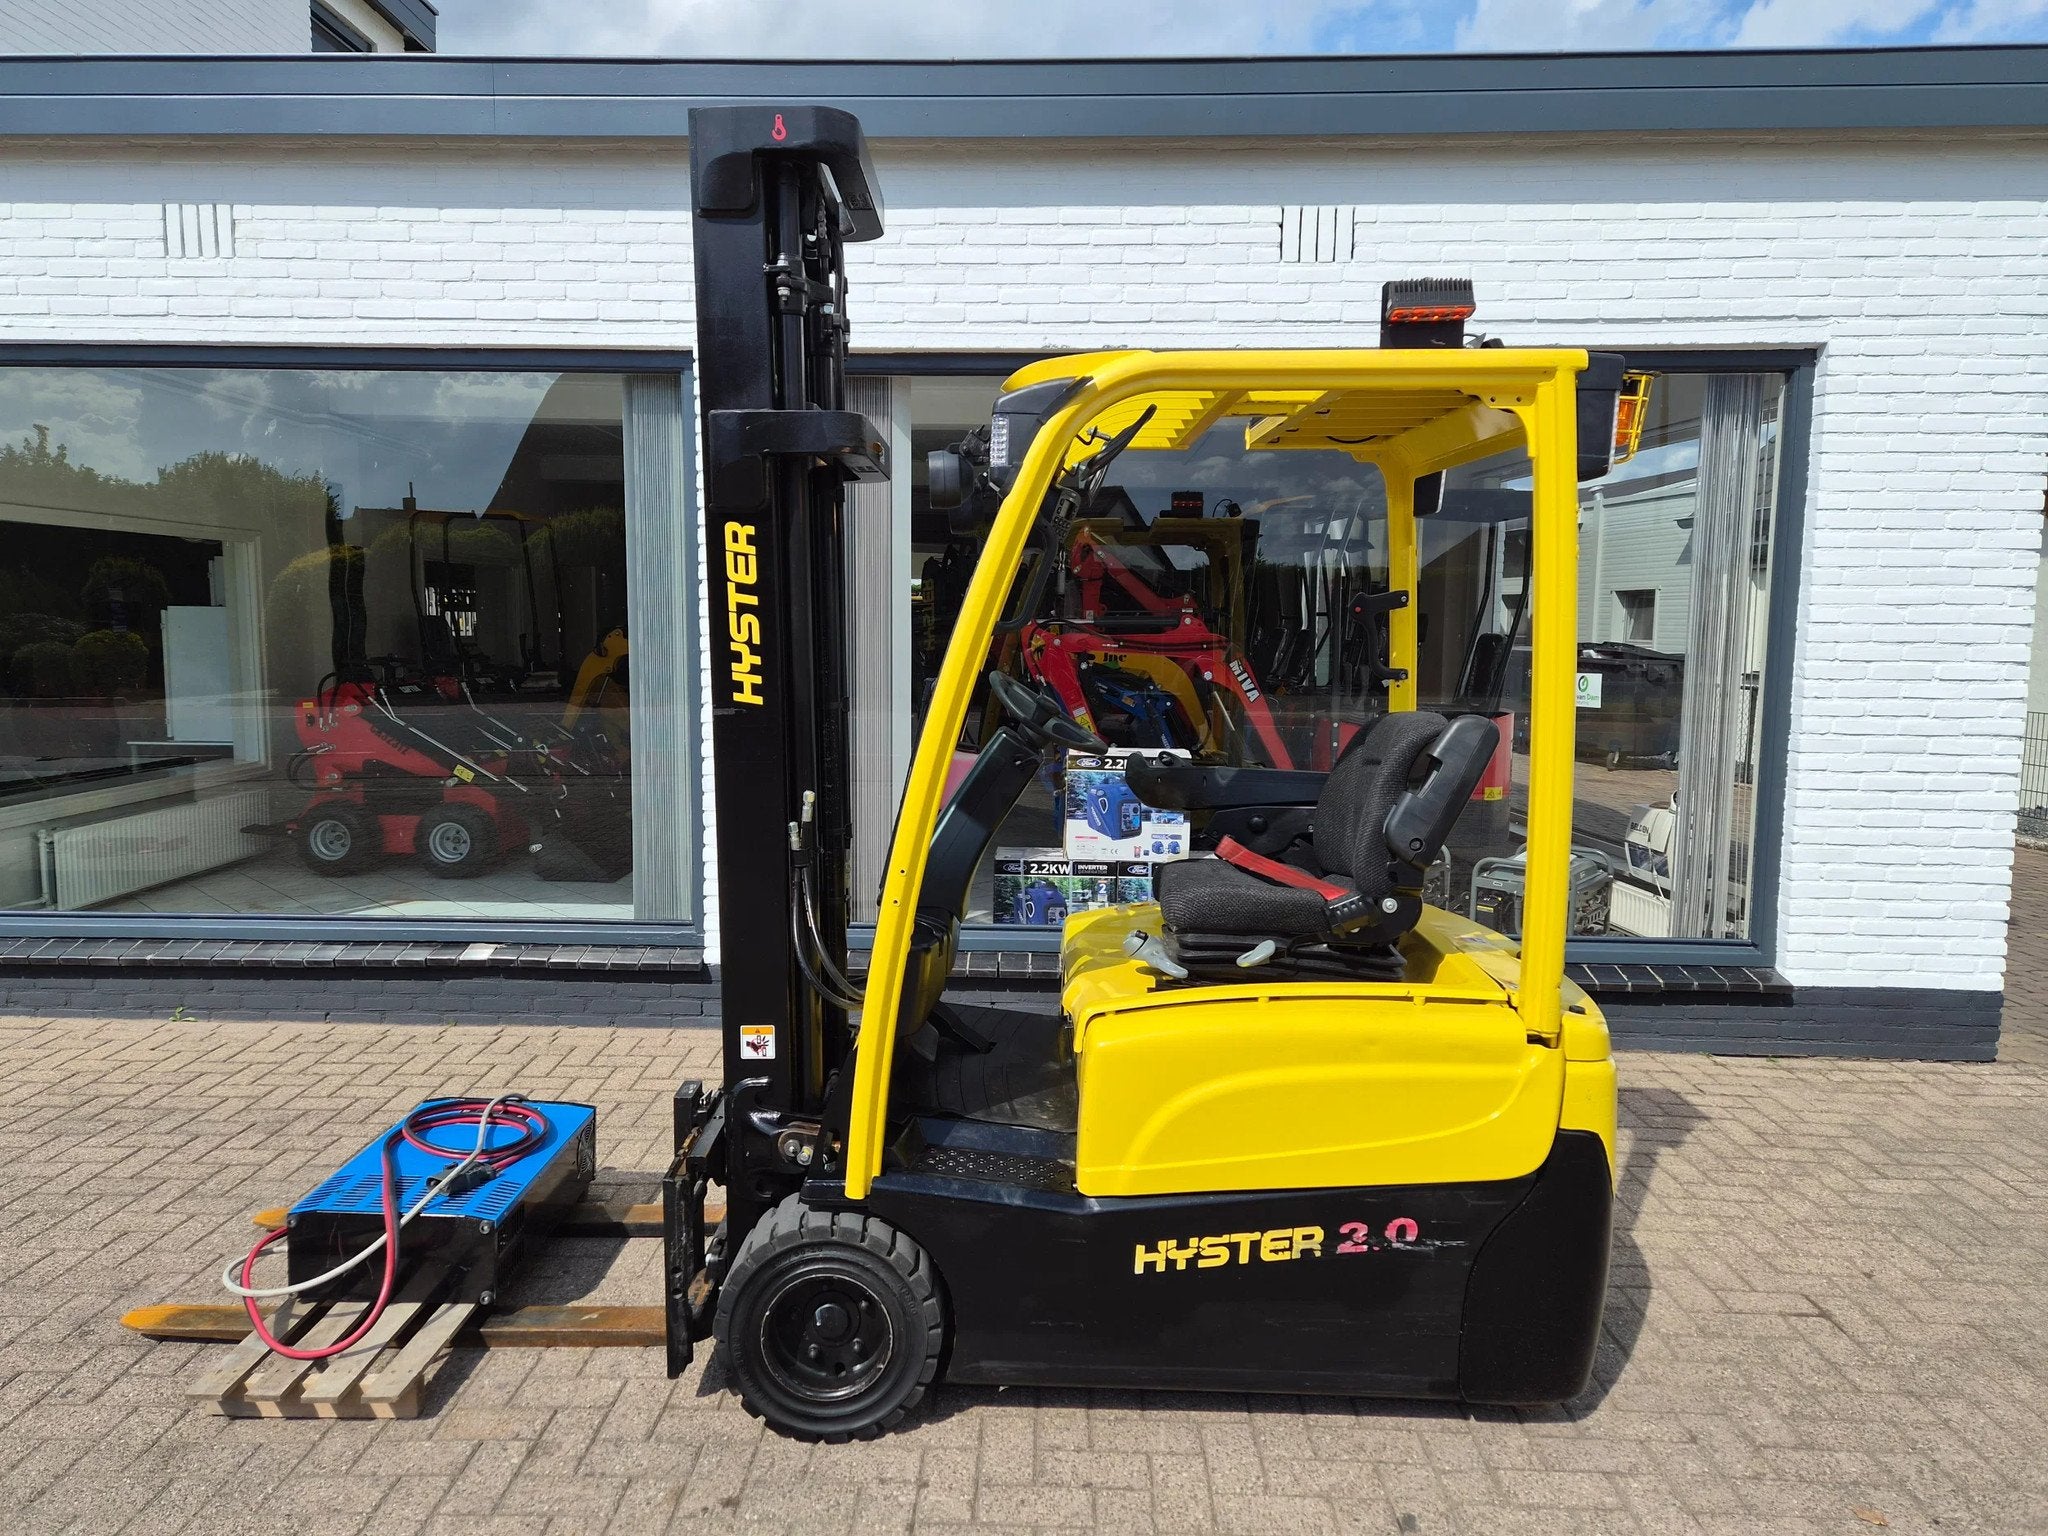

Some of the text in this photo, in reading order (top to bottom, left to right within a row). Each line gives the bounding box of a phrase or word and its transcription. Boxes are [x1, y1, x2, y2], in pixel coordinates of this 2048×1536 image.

[724, 521, 764, 705] HYSTER
[1079, 758, 1127, 769] Ford 2.2
[1030, 863, 1070, 875] 2.2KW
[1098, 883, 1107, 894] 2
[1134, 1217, 1419, 1275] HYSTER 2.0
